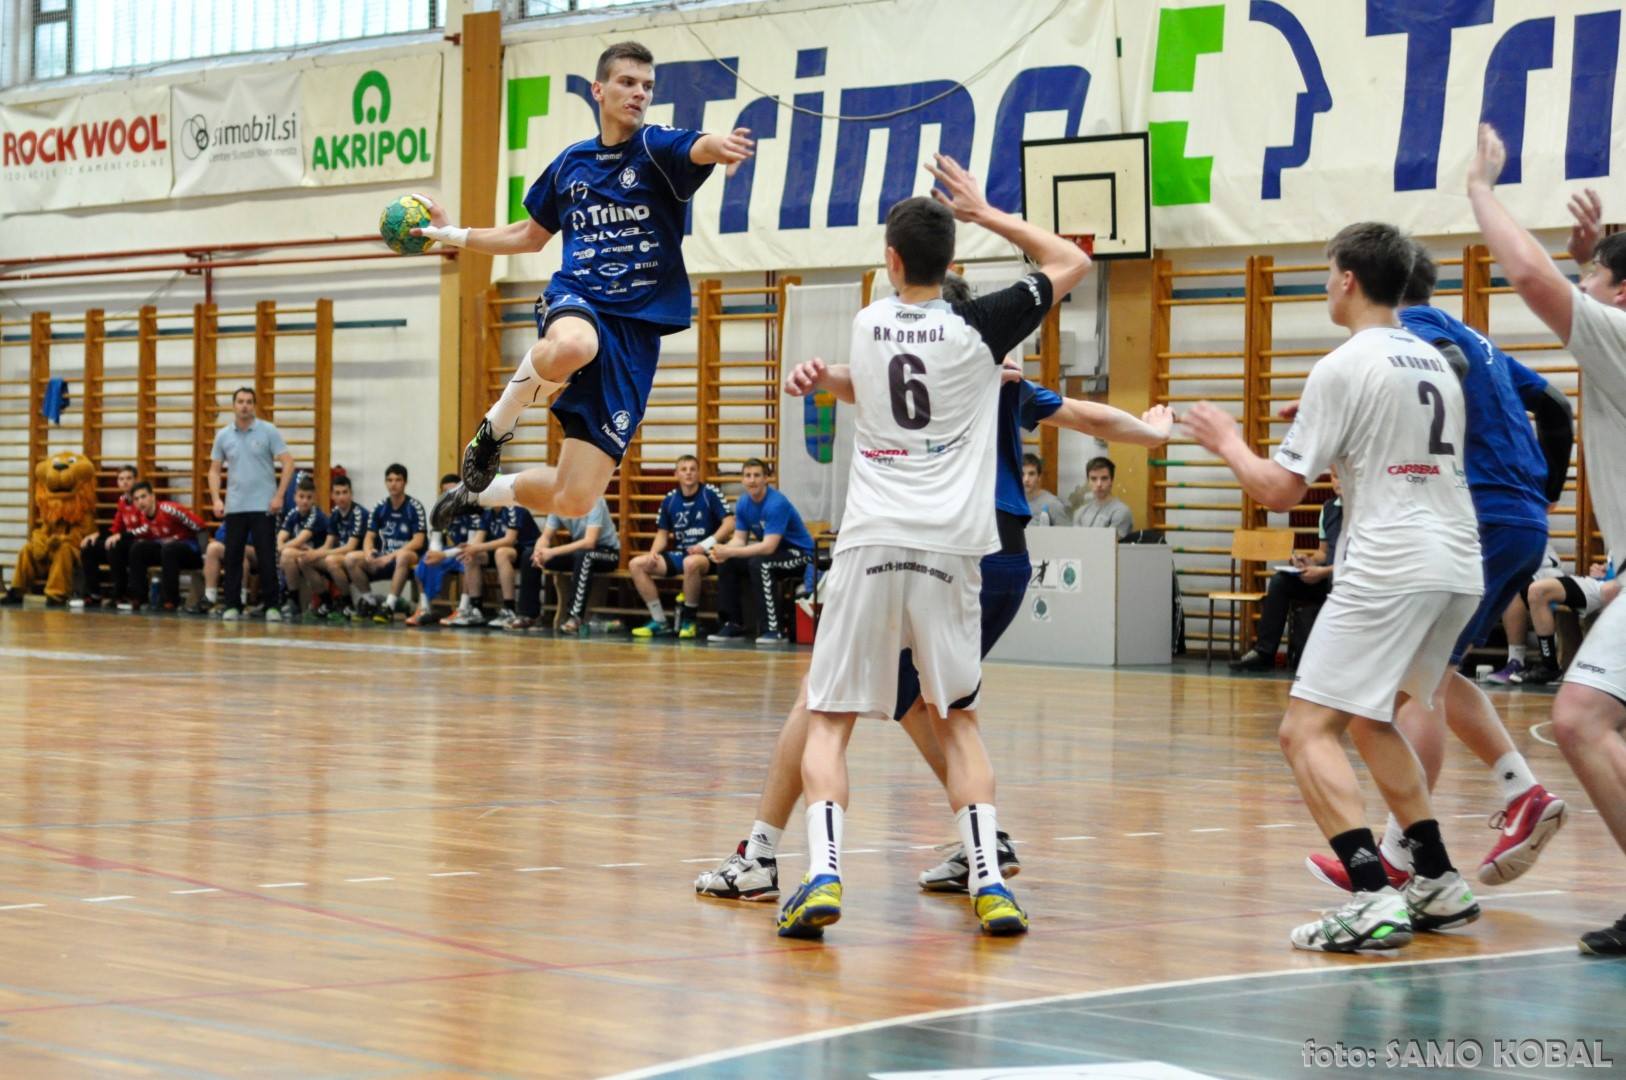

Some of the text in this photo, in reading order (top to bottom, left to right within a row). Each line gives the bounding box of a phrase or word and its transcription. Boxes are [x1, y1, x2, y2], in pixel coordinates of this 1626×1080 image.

[3, 113, 167, 167] ROCKWOOL
[212, 112, 296, 147] simobil.si
[312, 127, 431, 171] AKRIPOL
[874, 325, 892, 341] RK
[888, 353, 931, 430] 6
[1418, 380, 1455, 456] 2
[1387, 463, 1441, 476] CARRERA
